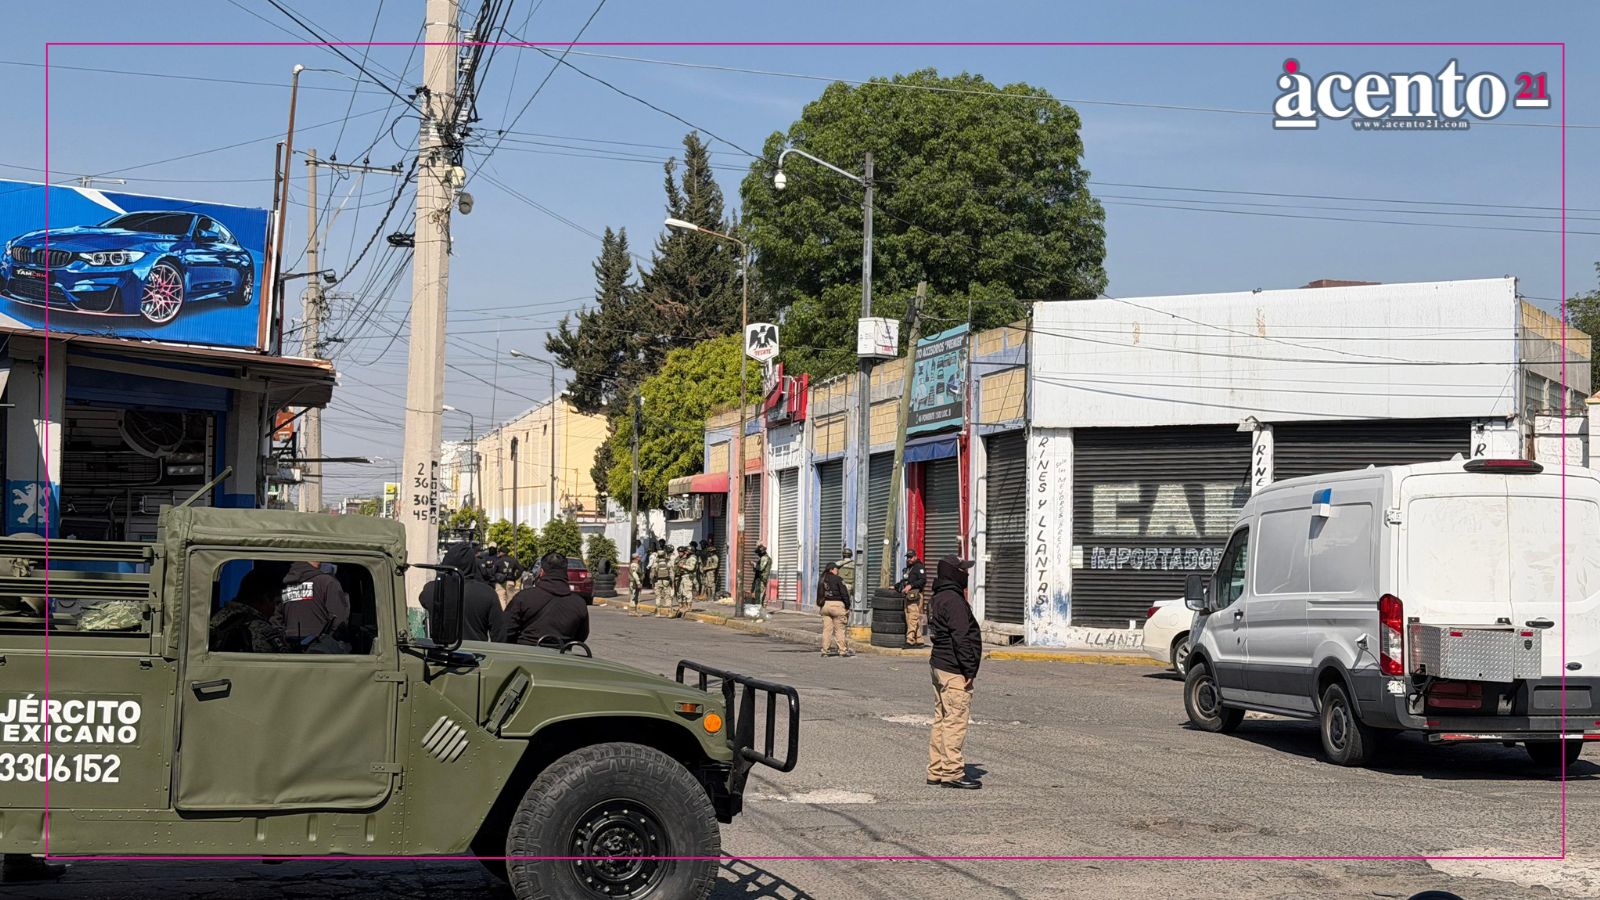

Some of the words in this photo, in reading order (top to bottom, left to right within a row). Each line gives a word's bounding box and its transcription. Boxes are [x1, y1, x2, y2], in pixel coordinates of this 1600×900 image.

[417, 462, 425, 476] 2
[1037, 437, 1050, 493] RINES
[413, 477, 429, 489] 36
[413, 494, 429, 506] 30
[430, 460, 438, 525] PLOMERO
[413, 510, 428, 521] 45
[1035, 515, 1049, 606] LLANTAS
[1085, 631, 1144, 648] LLANT
